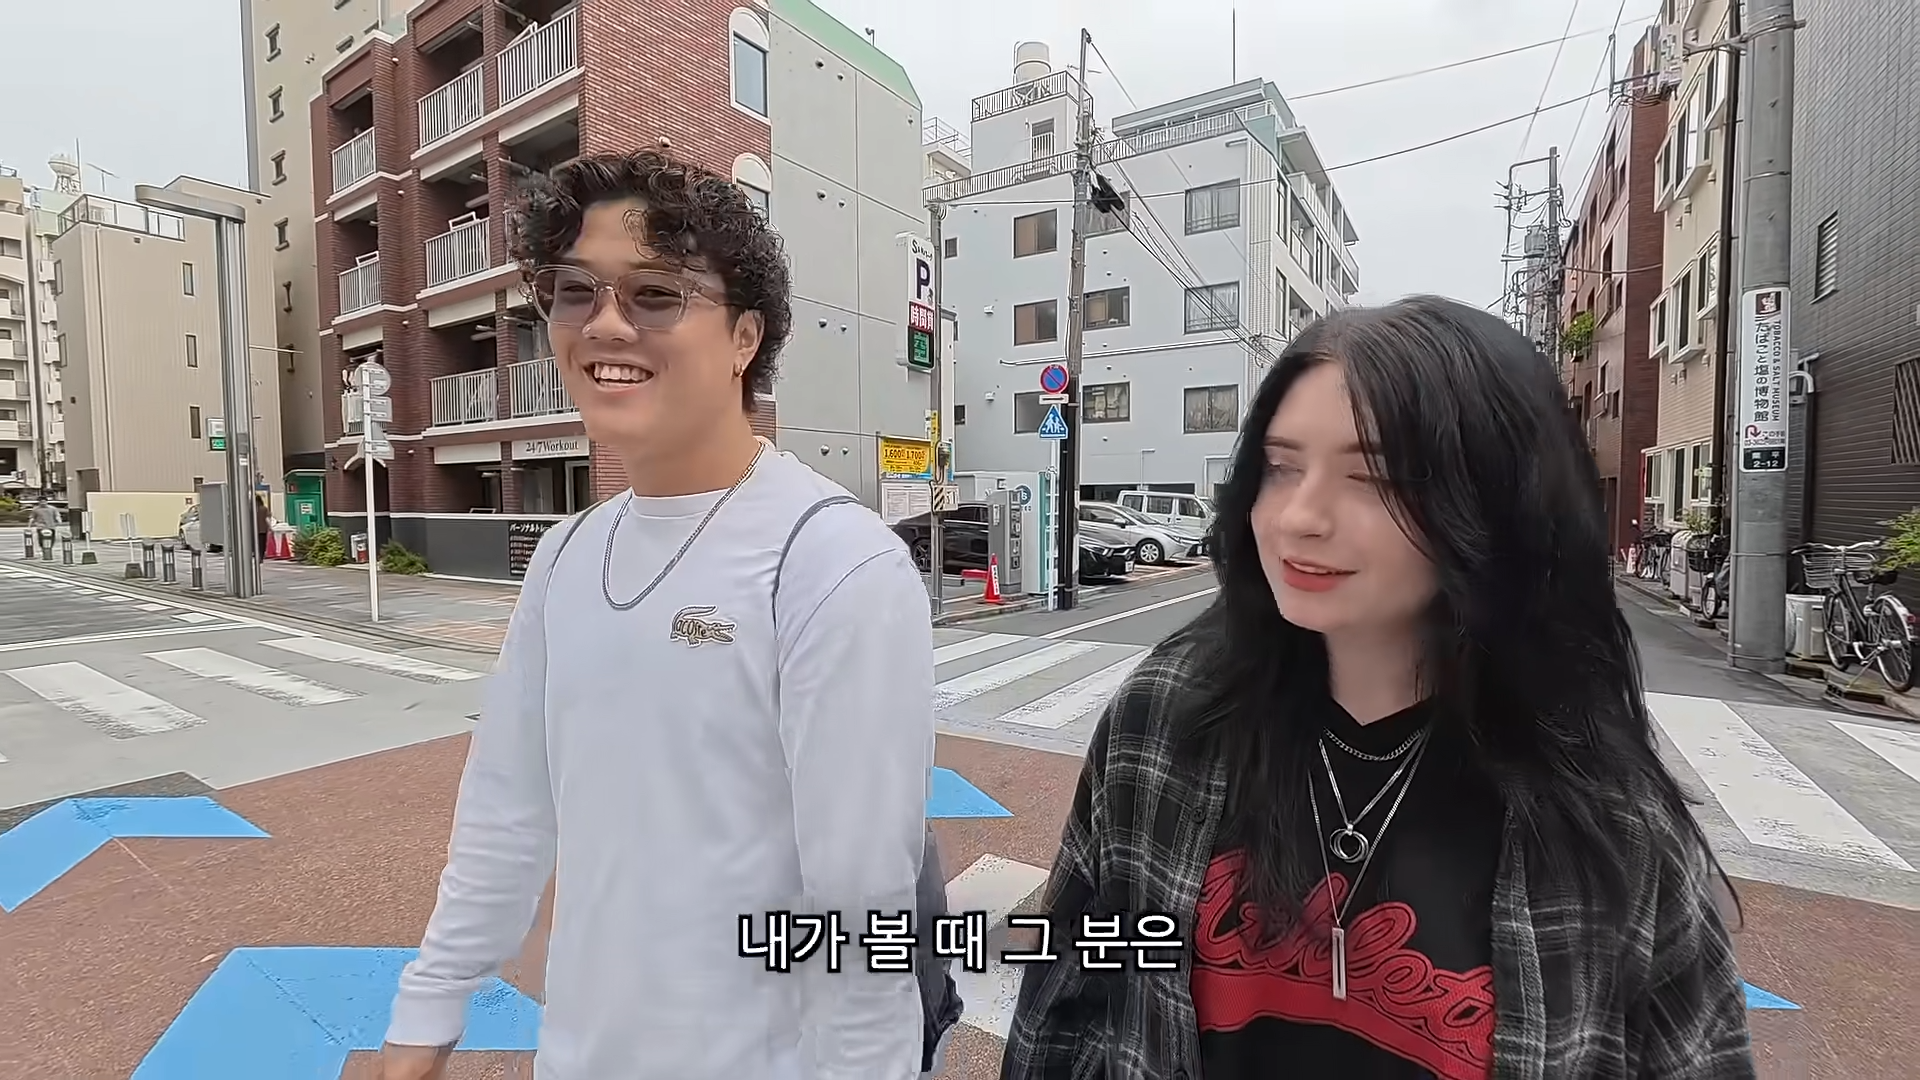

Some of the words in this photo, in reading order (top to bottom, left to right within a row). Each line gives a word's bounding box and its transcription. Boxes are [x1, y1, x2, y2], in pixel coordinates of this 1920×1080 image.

[917, 257, 931, 300] P
[1772, 319, 1782, 357] TOBACCO
[1753, 321, 1770, 422] たばこと塩の博物館
[1772, 365, 1781, 386] SALT
[1771, 387, 1781, 422] MUSEUM
[1753, 459, 1779, 468] 2-12
